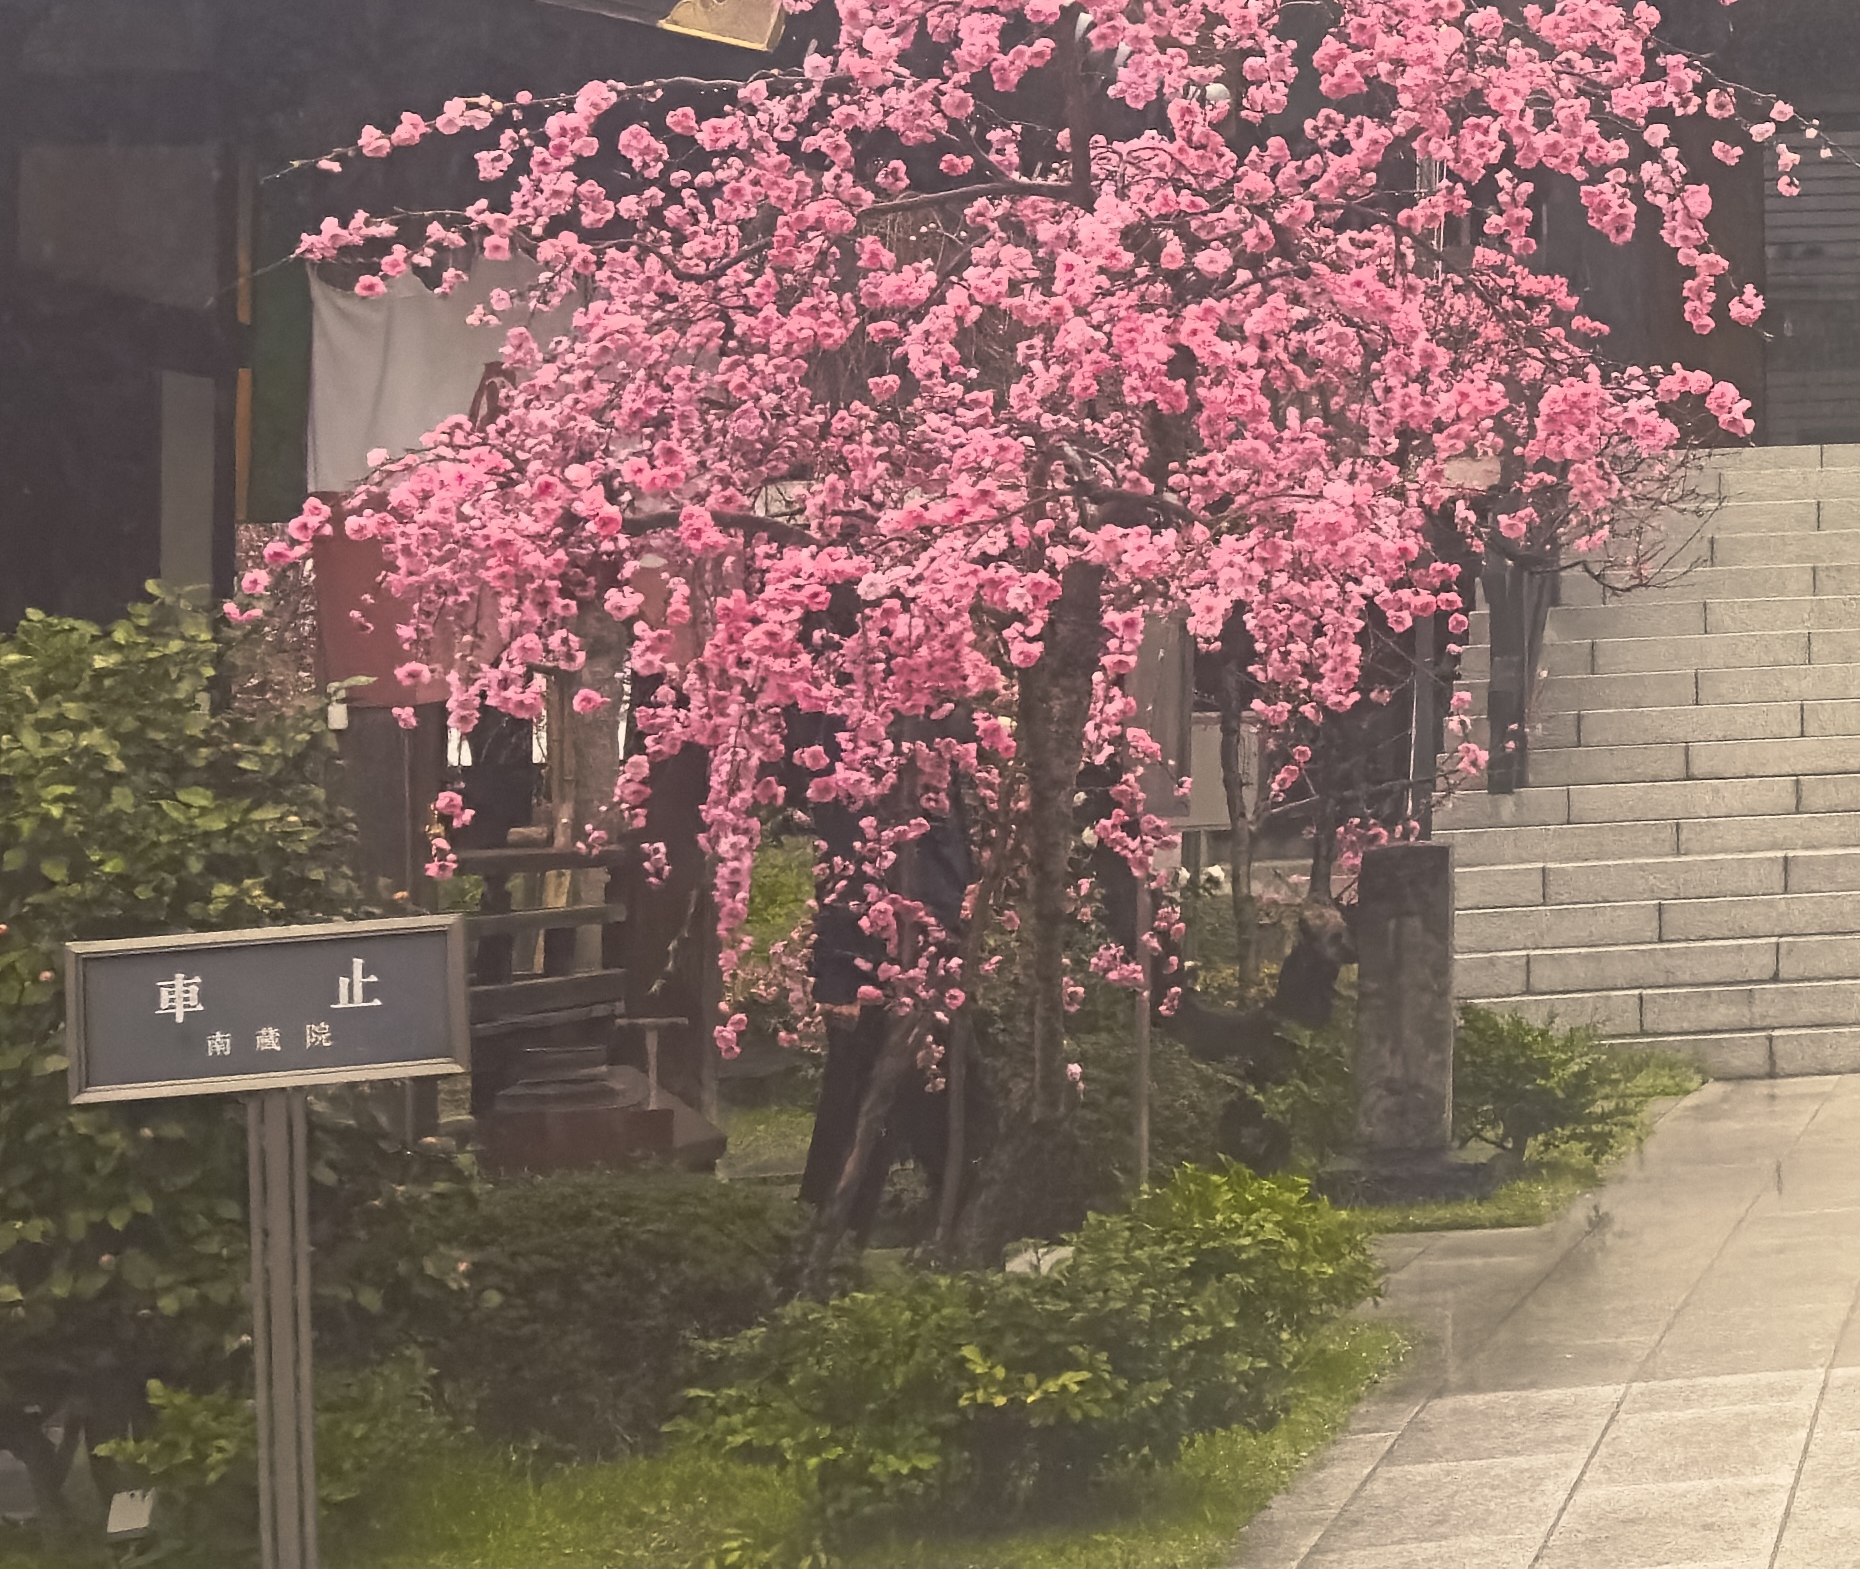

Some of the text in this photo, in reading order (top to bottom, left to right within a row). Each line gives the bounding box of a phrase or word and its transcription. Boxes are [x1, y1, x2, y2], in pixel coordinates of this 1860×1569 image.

[154, 957, 383, 1024] 車止
[206, 1021, 333, 1057] 南蔵院
